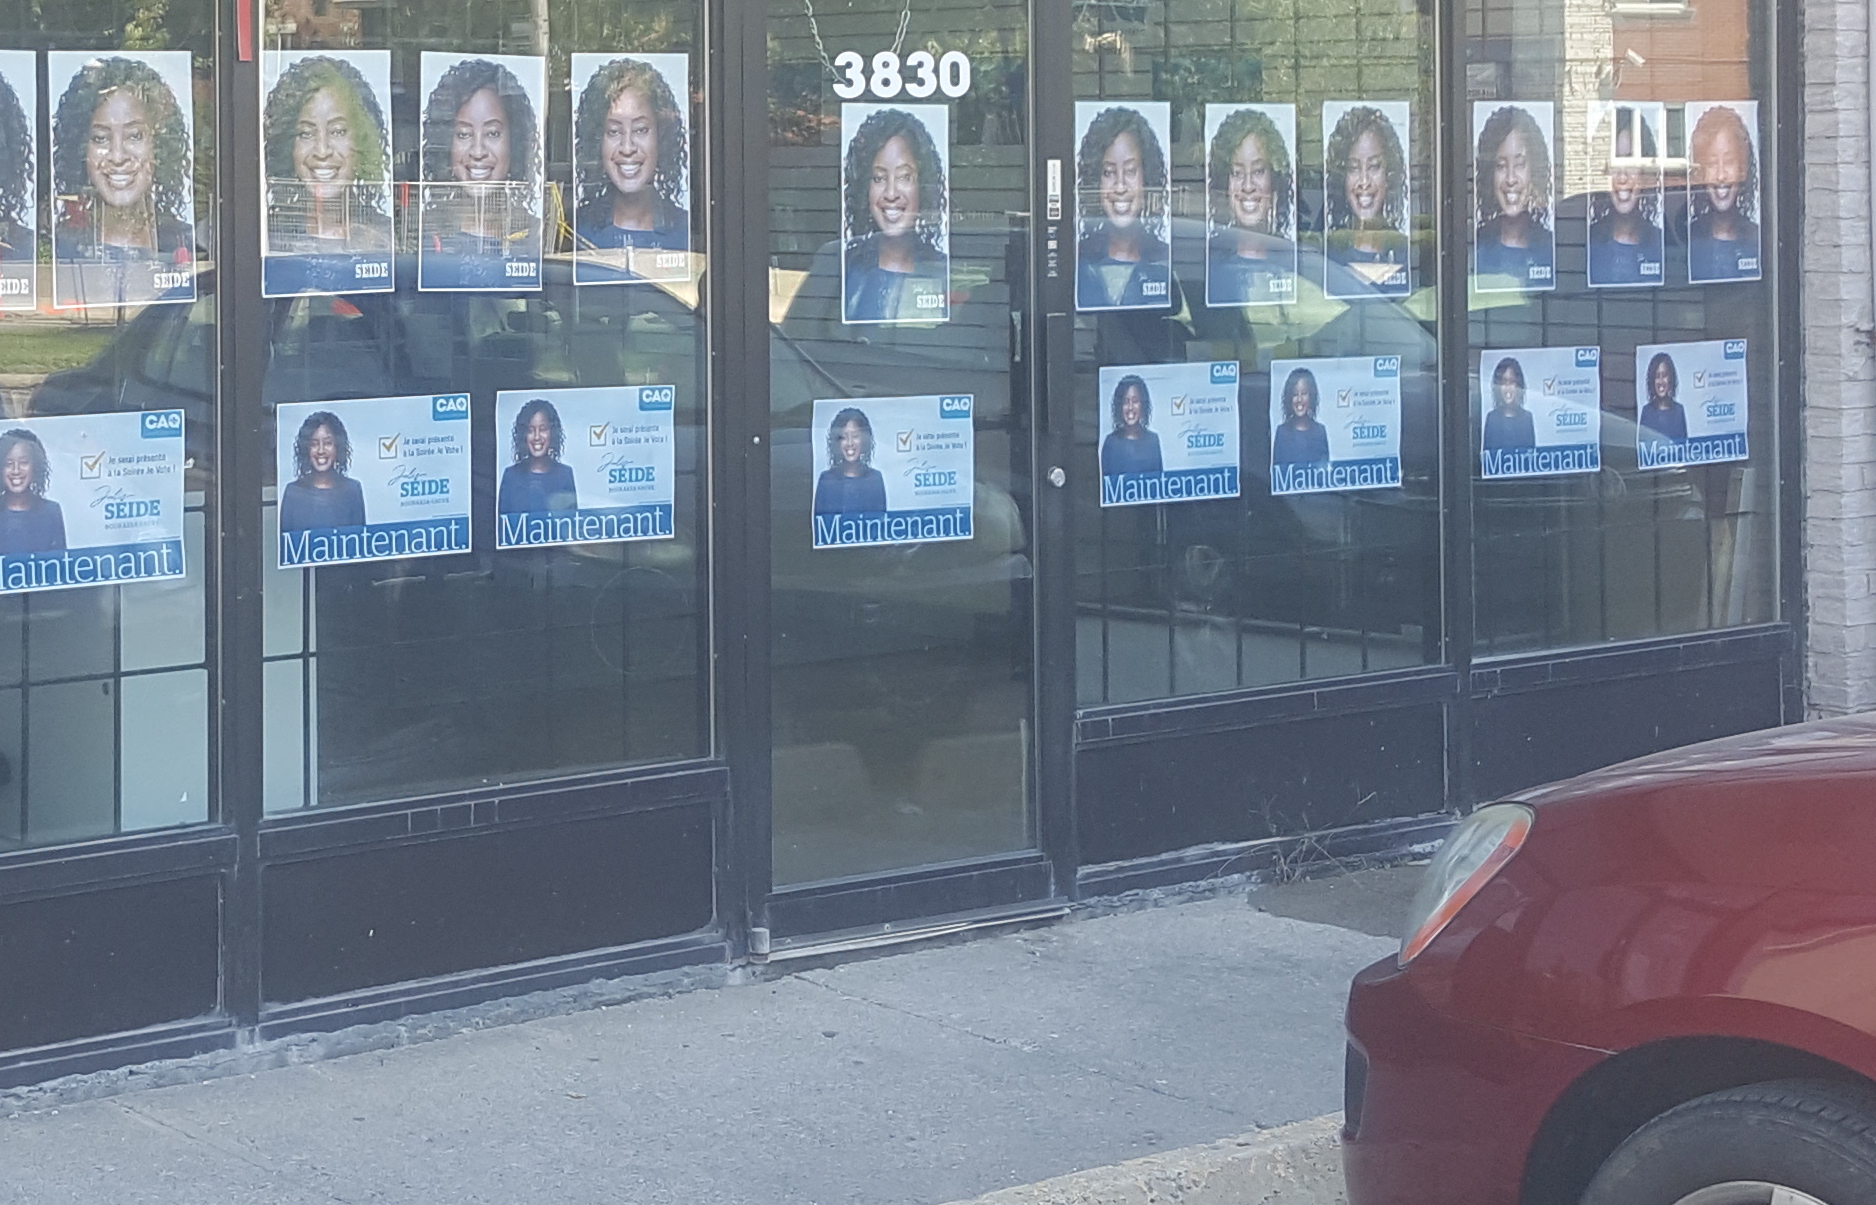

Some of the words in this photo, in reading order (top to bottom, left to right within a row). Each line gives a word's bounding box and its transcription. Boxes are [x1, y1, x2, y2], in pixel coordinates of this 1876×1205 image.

[833, 51, 970, 98] 3830
[1213, 365, 1236, 377] CAQ
[1376, 358, 1397, 371] CAQ
[436, 397, 467, 413] CAQ
[642, 388, 671, 403] CAQ
[942, 398, 970, 412] CAQ
[145, 413, 181, 430] CAQ
[1483, 446, 1599, 475] Maintenant.
[1640, 437, 1746, 468] Maintenant.
[1103, 471, 1237, 504] Maintenant.
[1274, 461, 1399, 493] Maintenant.
[281, 519, 466, 565] Maintenant.
[500, 508, 672, 547] Maintenant.
[815, 508, 969, 546] Maintenant.
